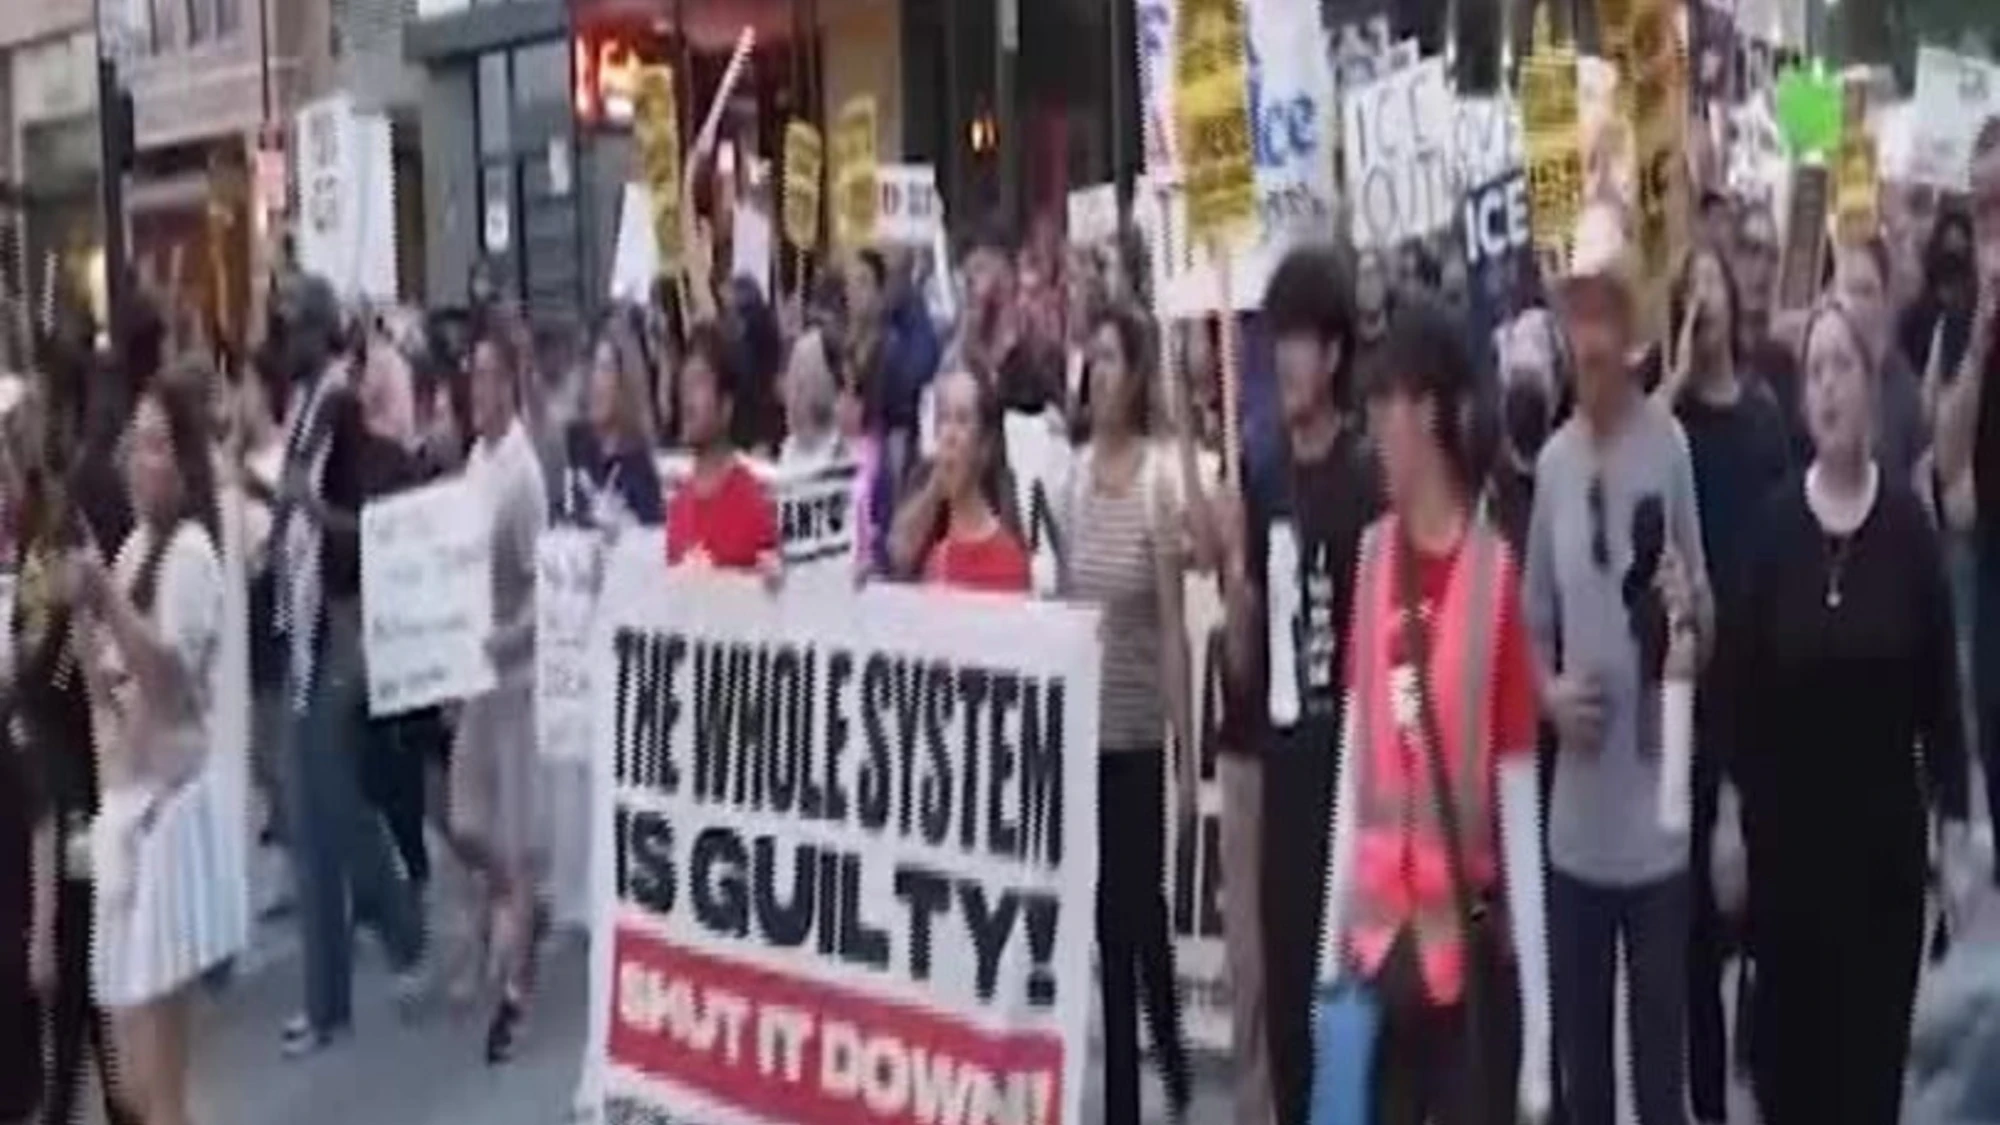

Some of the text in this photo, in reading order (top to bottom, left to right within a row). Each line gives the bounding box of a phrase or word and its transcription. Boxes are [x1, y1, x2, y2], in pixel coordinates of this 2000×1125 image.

[1356, 68, 1431, 169] ICE
[1464, 176, 1530, 264] ICE
[614, 626, 1066, 870] THE WHOLE SYSTEM
[614, 803, 678, 914] IS
[690, 827, 1060, 1006] GUILTY!
[620, 961, 750, 1067] SHUT
[756, 1003, 815, 1083] IT
